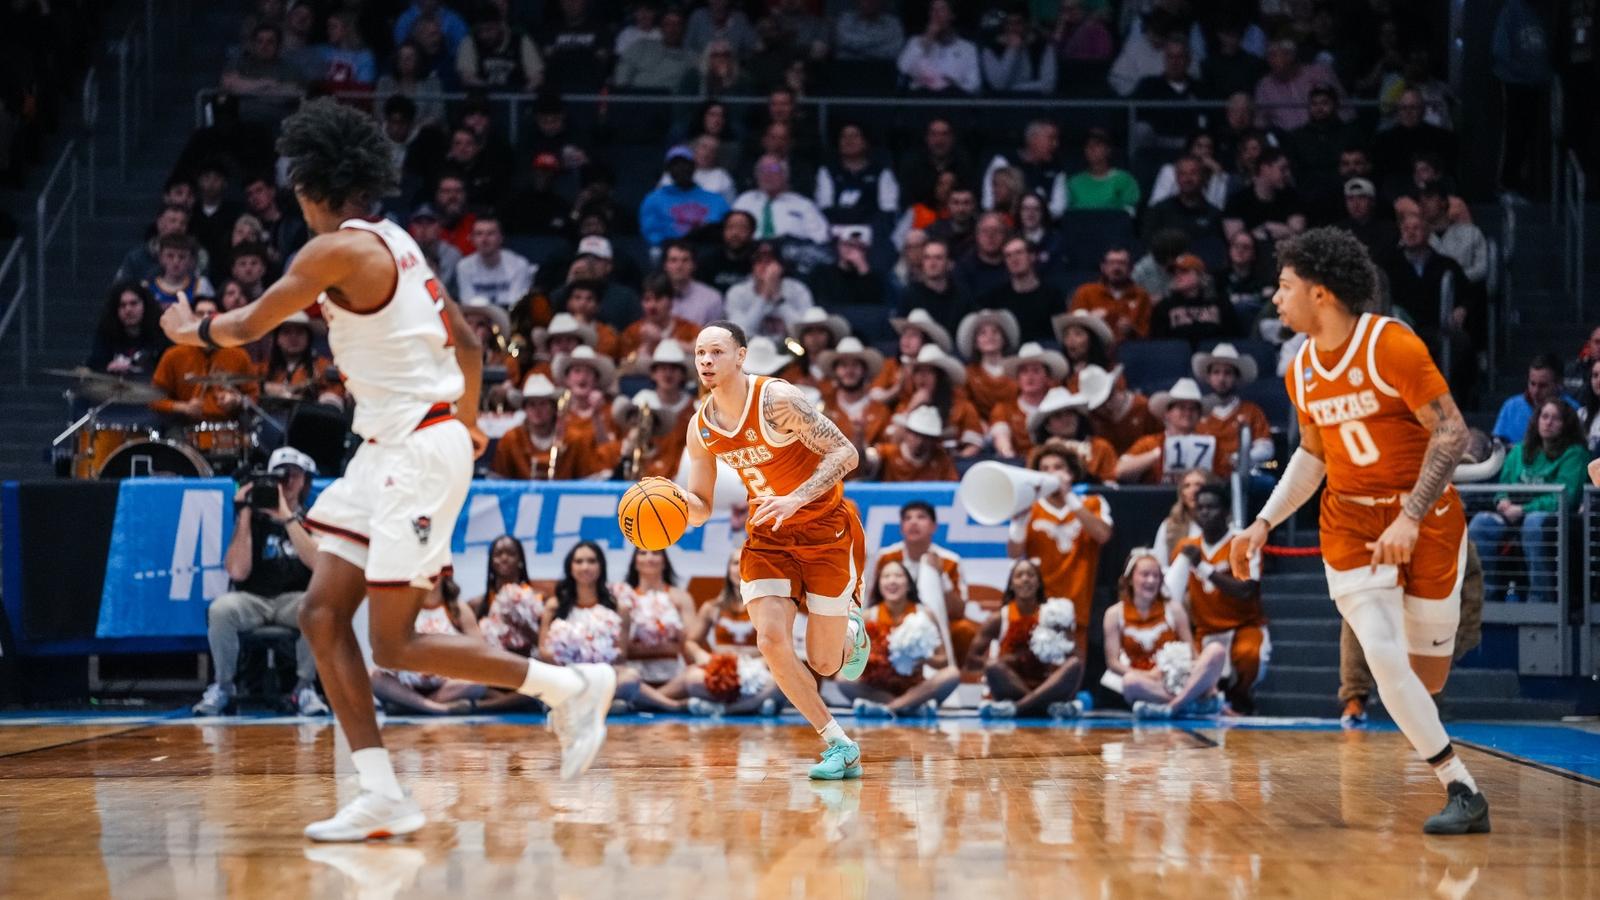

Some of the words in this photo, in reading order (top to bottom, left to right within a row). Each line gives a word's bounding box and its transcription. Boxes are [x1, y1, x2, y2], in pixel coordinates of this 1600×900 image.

[1307, 389, 1380, 427] TEXAS
[1170, 441, 1210, 469] 17
[1339, 420, 1380, 467] 0
[742, 467, 777, 498] 2
